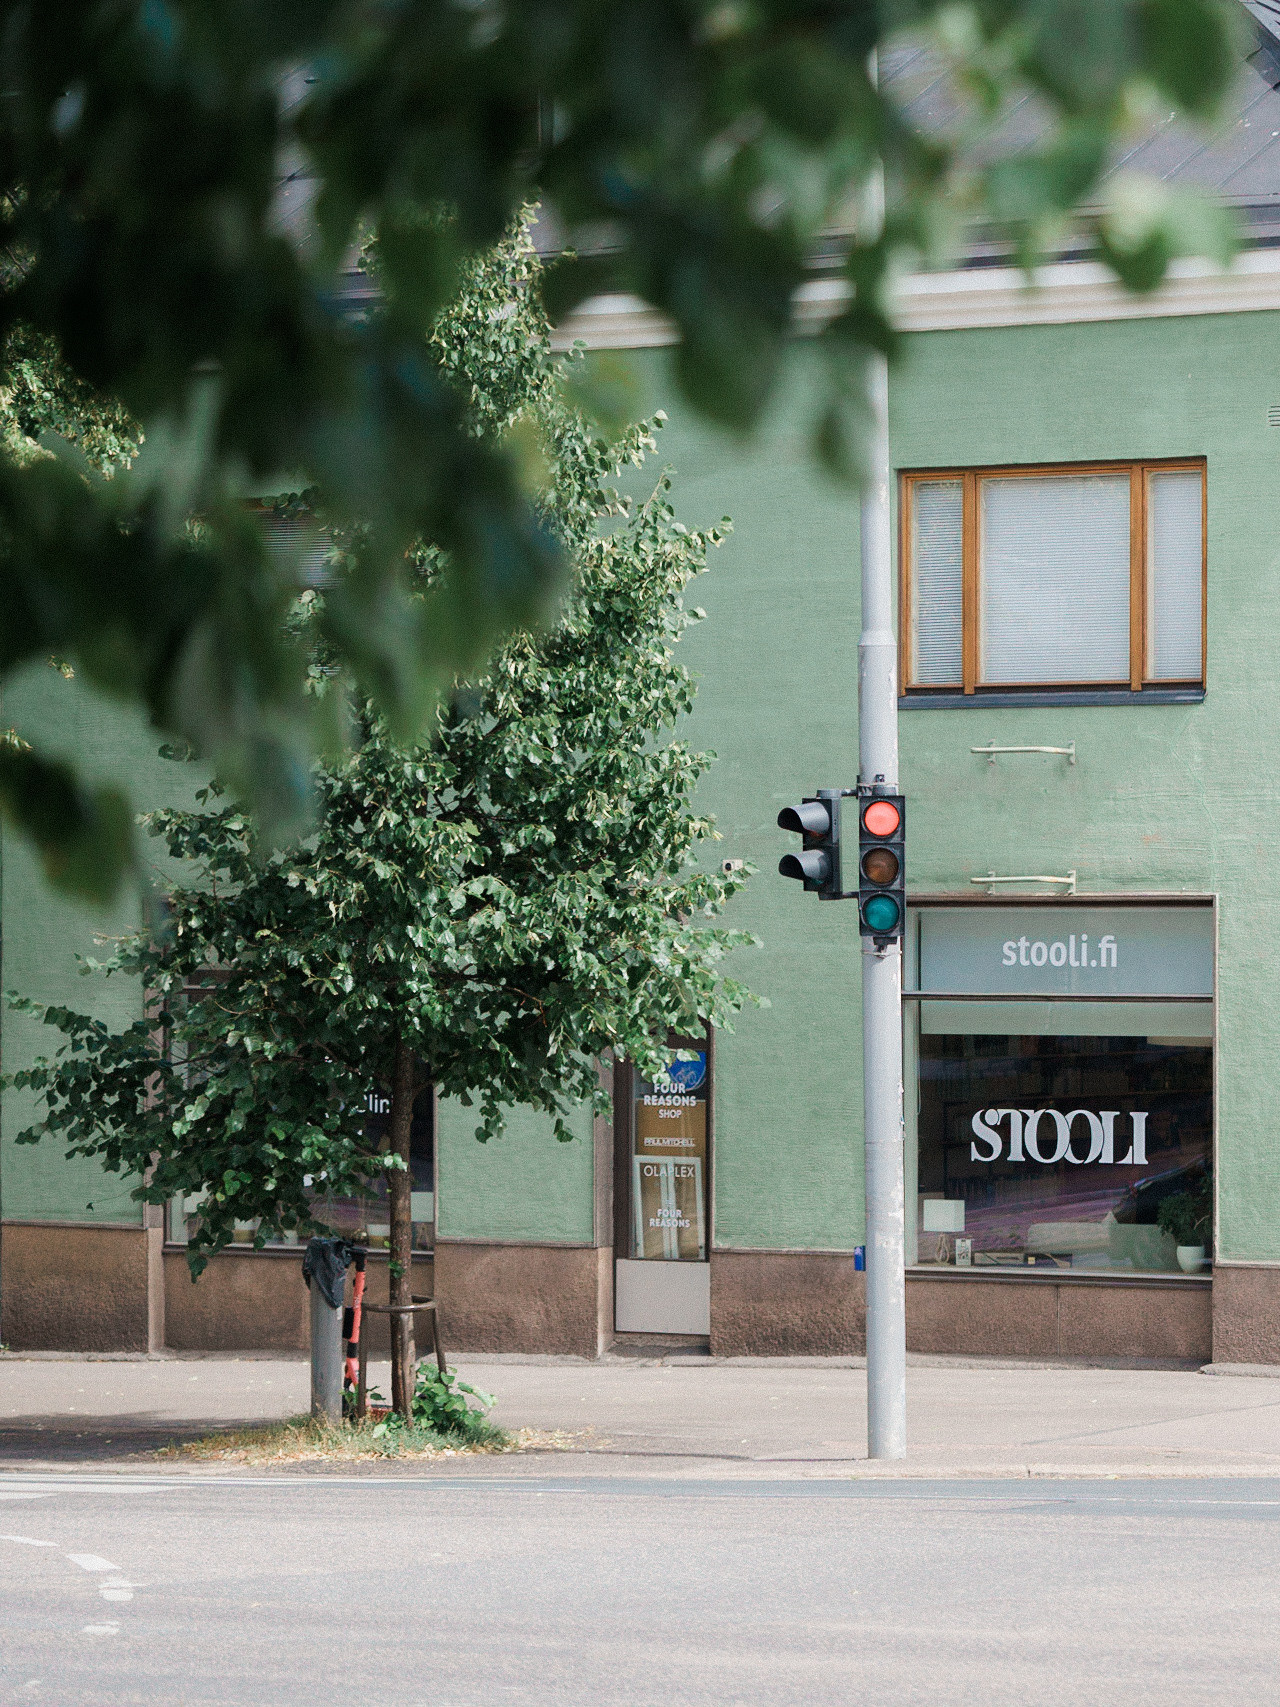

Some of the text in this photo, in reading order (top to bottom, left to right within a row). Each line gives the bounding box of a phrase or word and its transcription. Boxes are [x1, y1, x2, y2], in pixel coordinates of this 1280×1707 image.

[1001, 933, 1118, 968] stooli.fi
[653, 1083, 686, 1094] FOUR
[643, 1095, 697, 1107] REASONS
[658, 1109, 682, 1119] SHOP
[970, 1108, 1149, 1165] STOOLI
[643, 1164, 695, 1178] OLAPLEX
[657, 1208, 682, 1218] FOUR
[649, 1217, 691, 1228] REASONS
